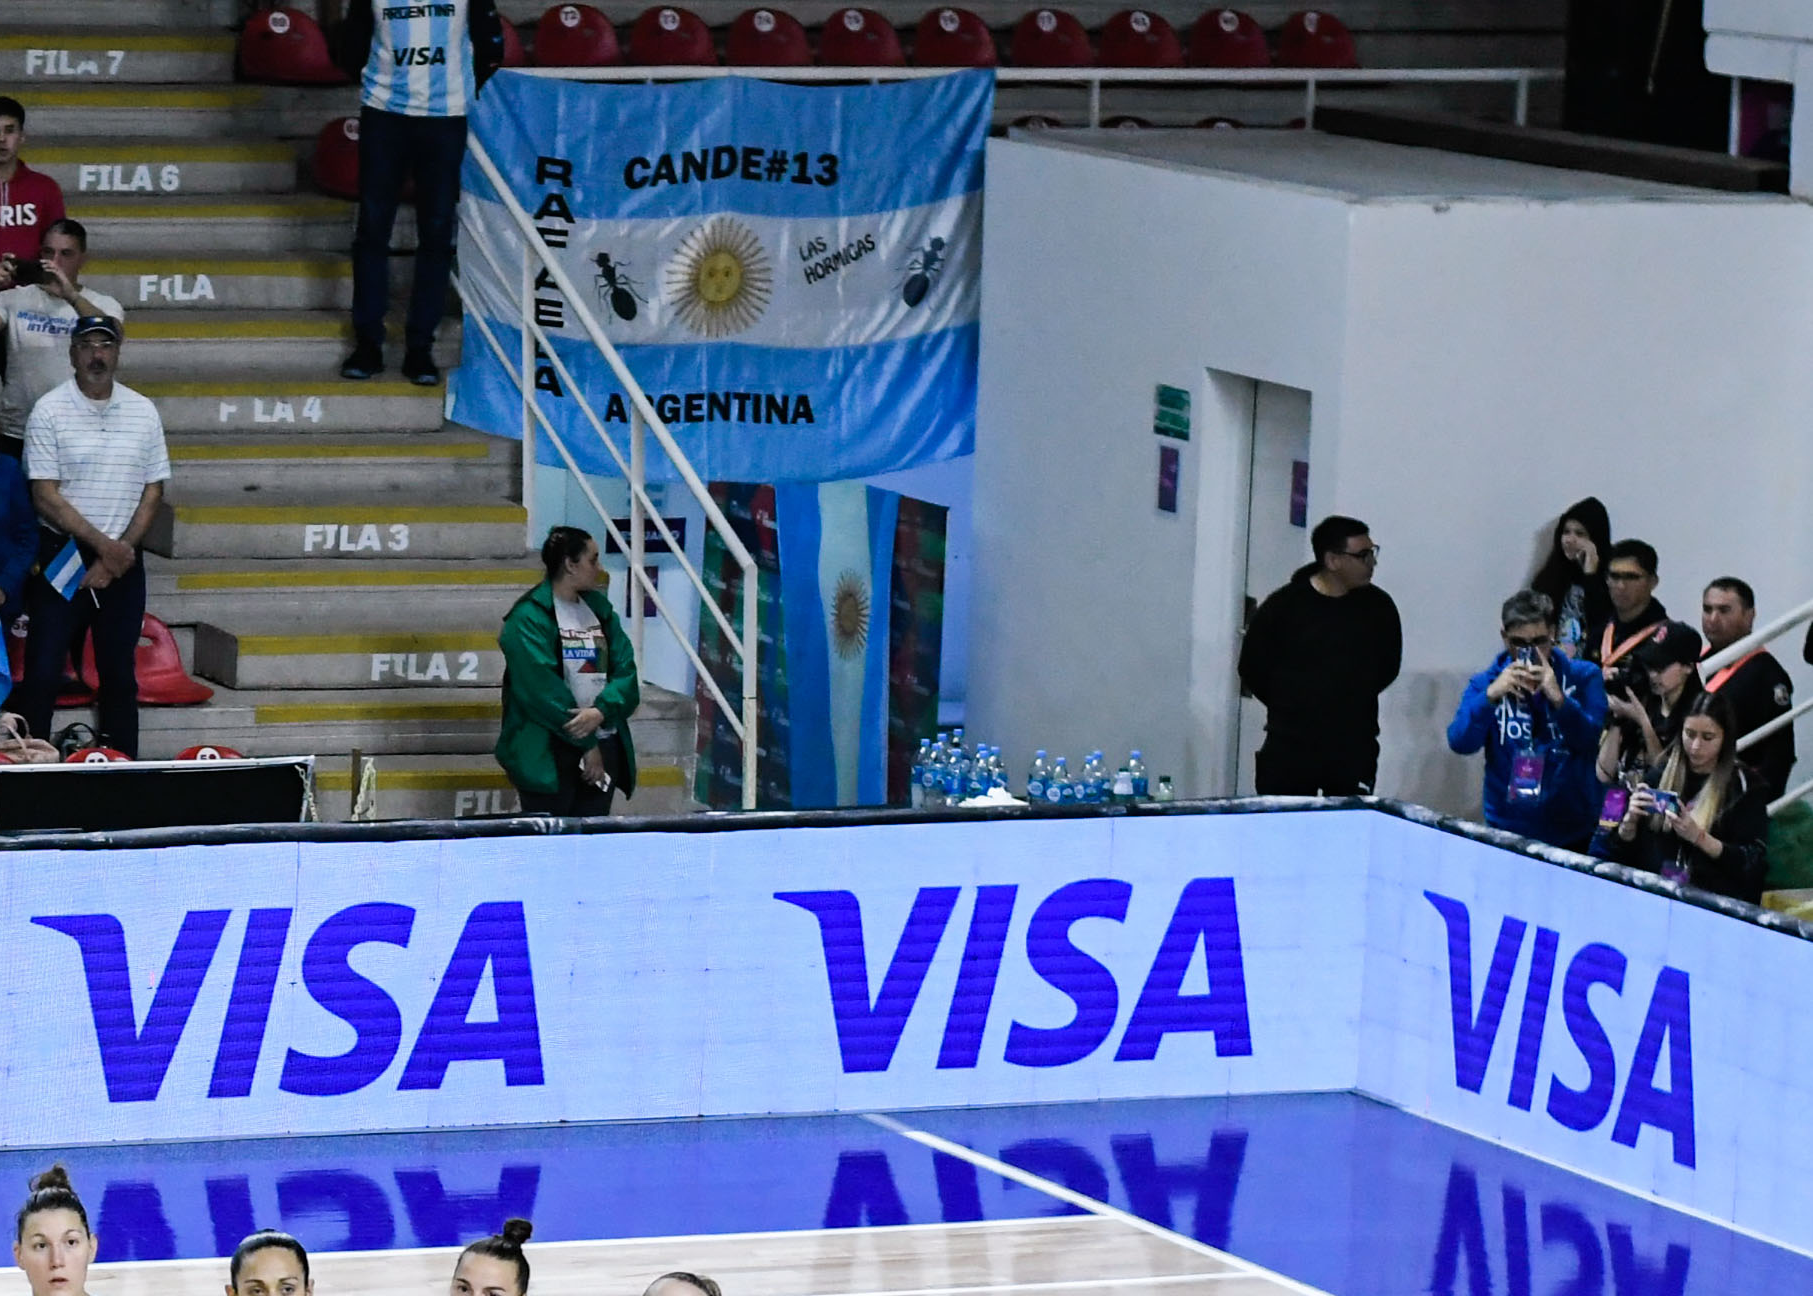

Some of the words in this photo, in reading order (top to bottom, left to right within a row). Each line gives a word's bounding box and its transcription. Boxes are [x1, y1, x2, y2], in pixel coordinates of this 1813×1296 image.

[108, 50, 124, 76] 7
[393, 47, 446, 66] VISA
[79, 165, 153, 191] FILA
[161, 165, 180, 191] 6
[624, 145, 839, 189] CANDE#13
[799, 236, 827, 262] LAS
[803, 233, 876, 285] HORMIGAS
[303, 396, 323, 424] 4
[304, 525, 381, 552] FILA
[388, 525, 410, 551] 3
[370, 653, 449, 681] FILA
[458, 652, 479, 680] 2
[772, 877, 1253, 1073] VISA
[30, 901, 545, 1102] VISA
[1423, 890, 1698, 1170] VISA
